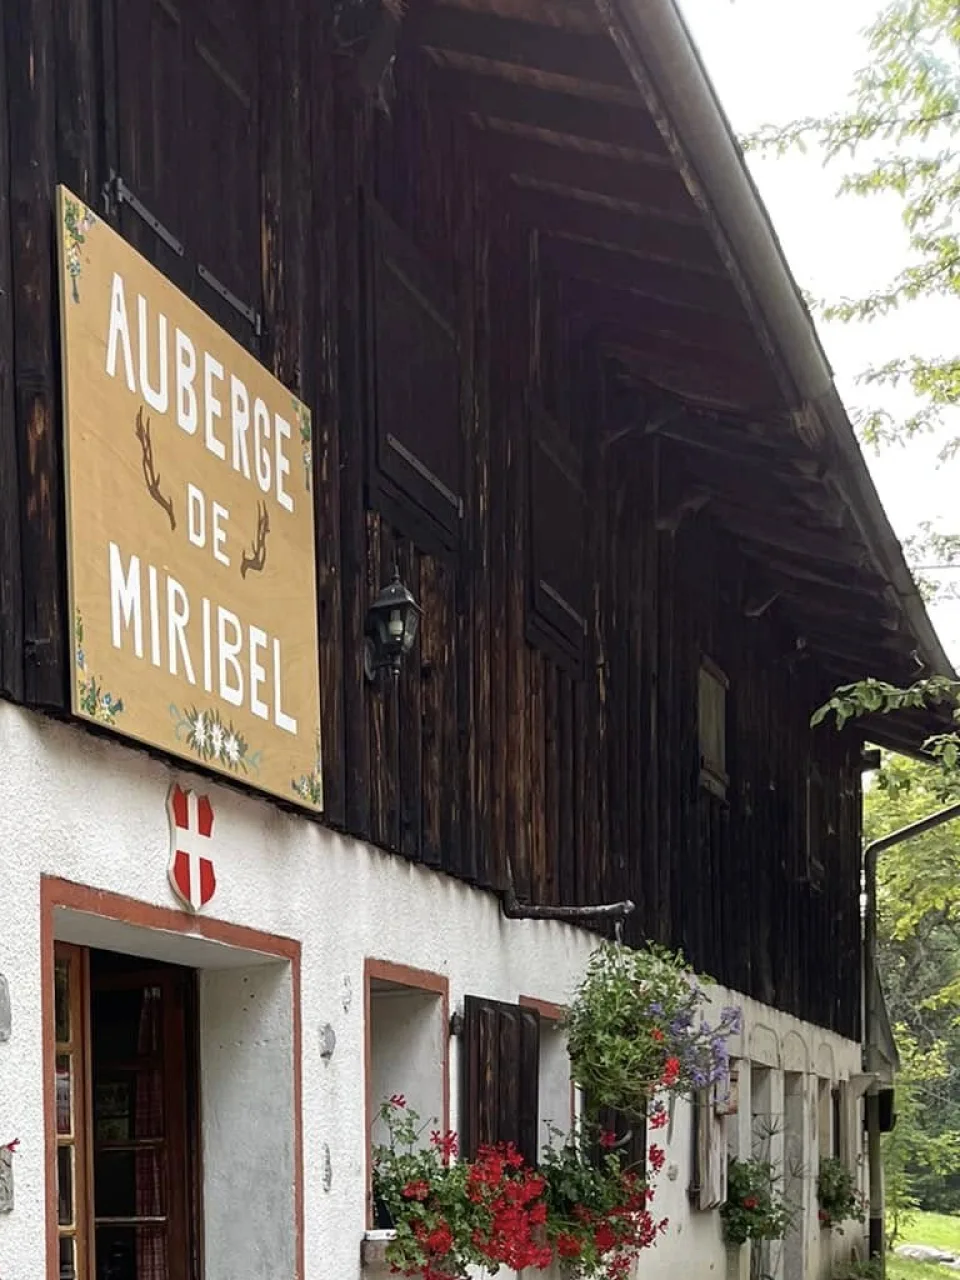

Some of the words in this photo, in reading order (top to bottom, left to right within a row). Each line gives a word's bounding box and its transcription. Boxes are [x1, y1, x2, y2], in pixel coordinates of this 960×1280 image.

[106, 271, 294, 513] AUBERGE
[187, 482, 231, 566] DE
[108, 540, 298, 735] MIRIBEL
